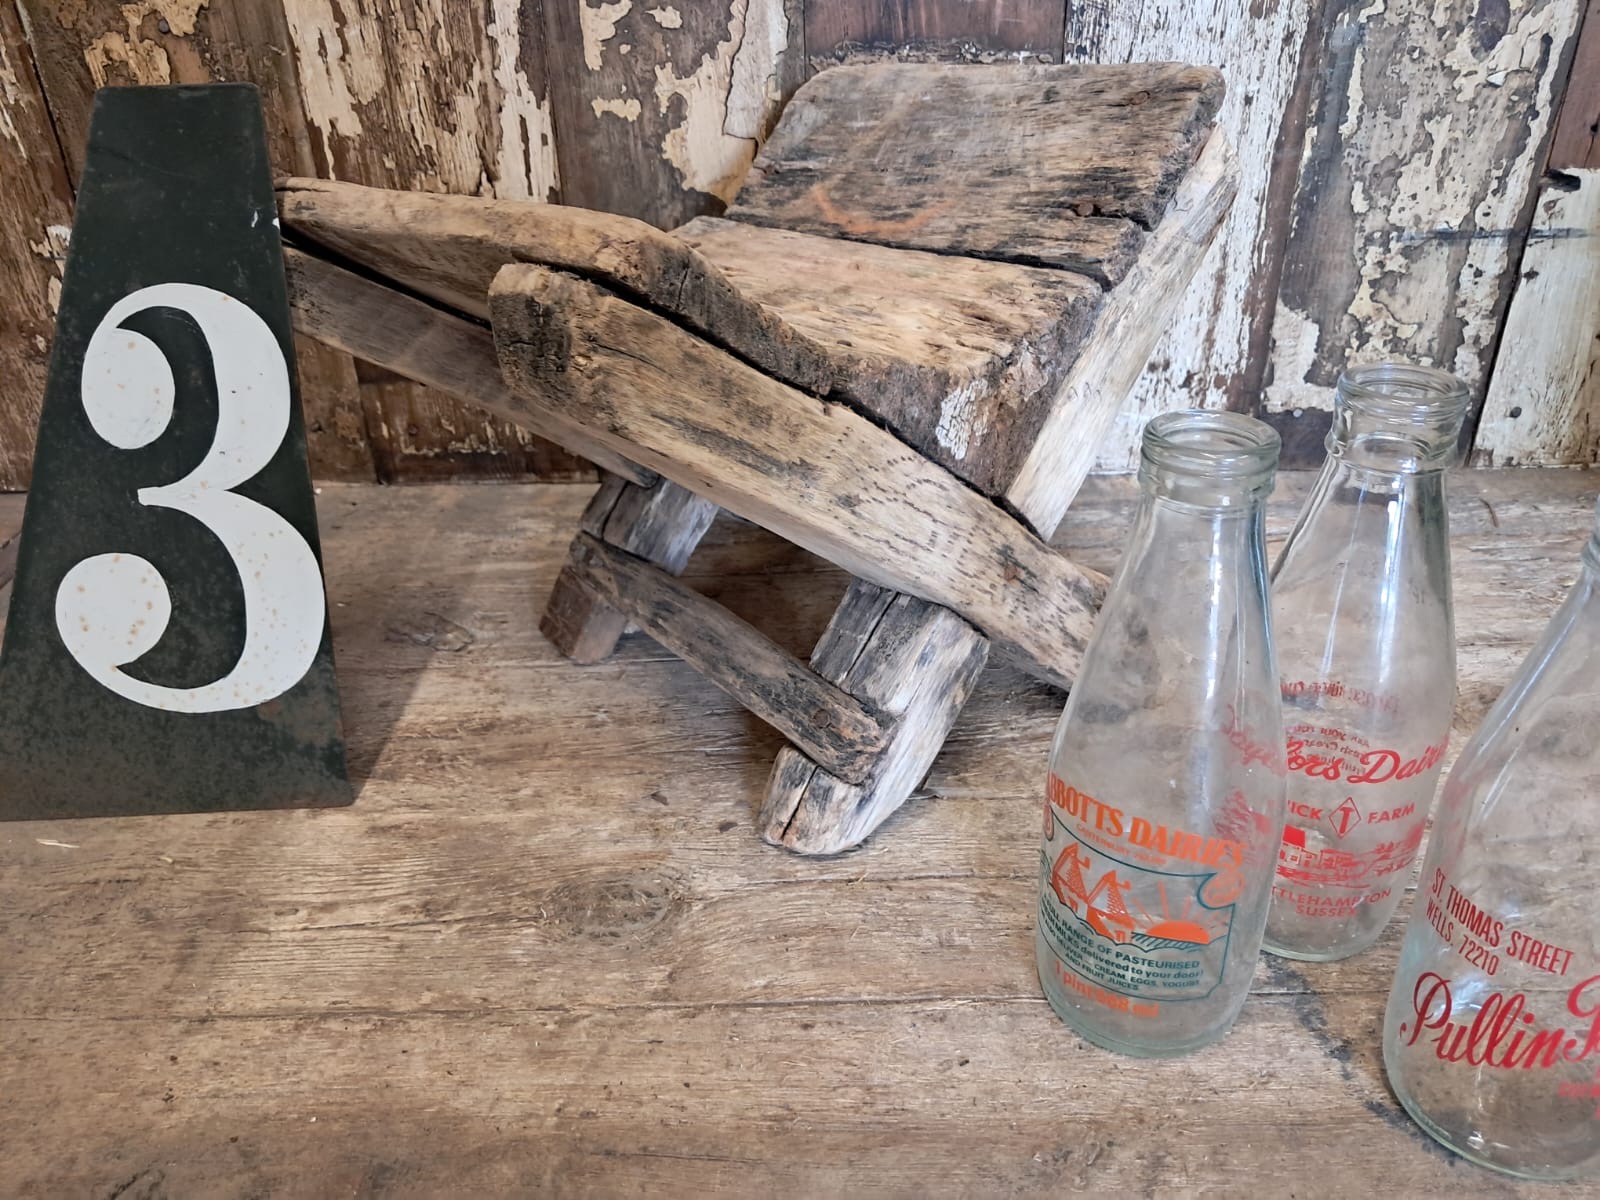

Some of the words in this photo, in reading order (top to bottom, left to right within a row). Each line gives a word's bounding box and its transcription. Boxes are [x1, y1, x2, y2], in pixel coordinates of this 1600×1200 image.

[55, 283, 325, 713] 3
[1287, 800, 1323, 820] ICK
[1368, 802, 1415, 824] FARM
[1128, 815, 1249, 870] DAIRIES
[1272, 885, 1392, 907] TTLEHAMPTON
[1296, 904, 1357, 917] SUSSEX
[1061, 919, 1095, 949] RANGE
[1097, 943, 1113, 956] OF
[1115, 951, 1200, 970] PASTEURISED
[1446, 884, 1504, 949] THOMAS
[1506, 930, 1575, 976] STREET
[1064, 951, 1081, 967] AND
[1082, 962, 1105, 980] FRUIT
[1108, 976, 1139, 991] JUICES
[1080, 945, 1130, 972] delivered
[1130, 966, 1143, 976] to
[1145, 970, 1171, 979] your
[1458, 933, 1500, 976] 72210
